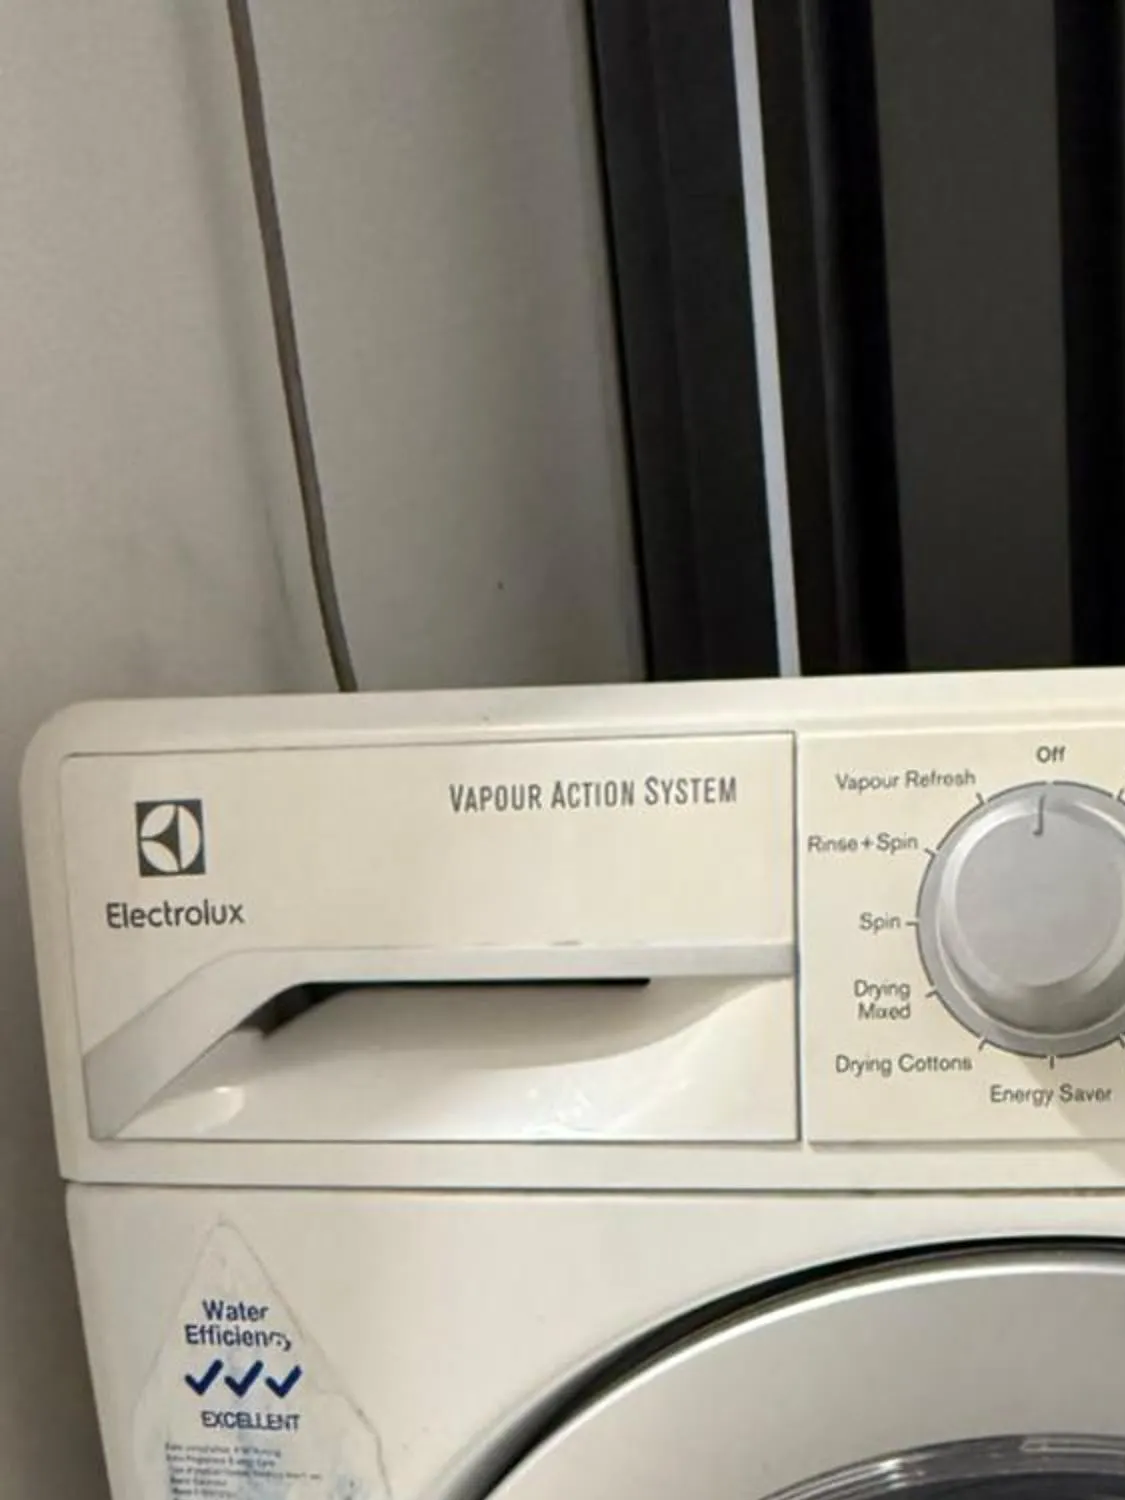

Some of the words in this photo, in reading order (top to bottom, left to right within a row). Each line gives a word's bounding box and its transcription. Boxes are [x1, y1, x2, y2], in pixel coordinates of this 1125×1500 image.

[1036, 745, 1066, 764] Off
[835, 772, 900, 794] Vapour
[904, 768, 976, 788] Refresh
[448, 783, 544, 813] VAPOUR
[551, 779, 636, 809] ACTION
[643, 775, 738, 807] SYSTEM
[105, 899, 246, 930] Electrolux
[859, 911, 901, 934] Spin
[854, 979, 911, 1001] Drying
[857, 1002, 911, 1021] Mixed
[835, 1054, 893, 1078] Drying
[899, 1053, 973, 1073] Cottons
[990, 1084, 1054, 1107] Energy
[1059, 1083, 1113, 1104] Saver
[202, 1298, 270, 1322] Water
[200, 1409, 302, 1431] EXCELLENT
